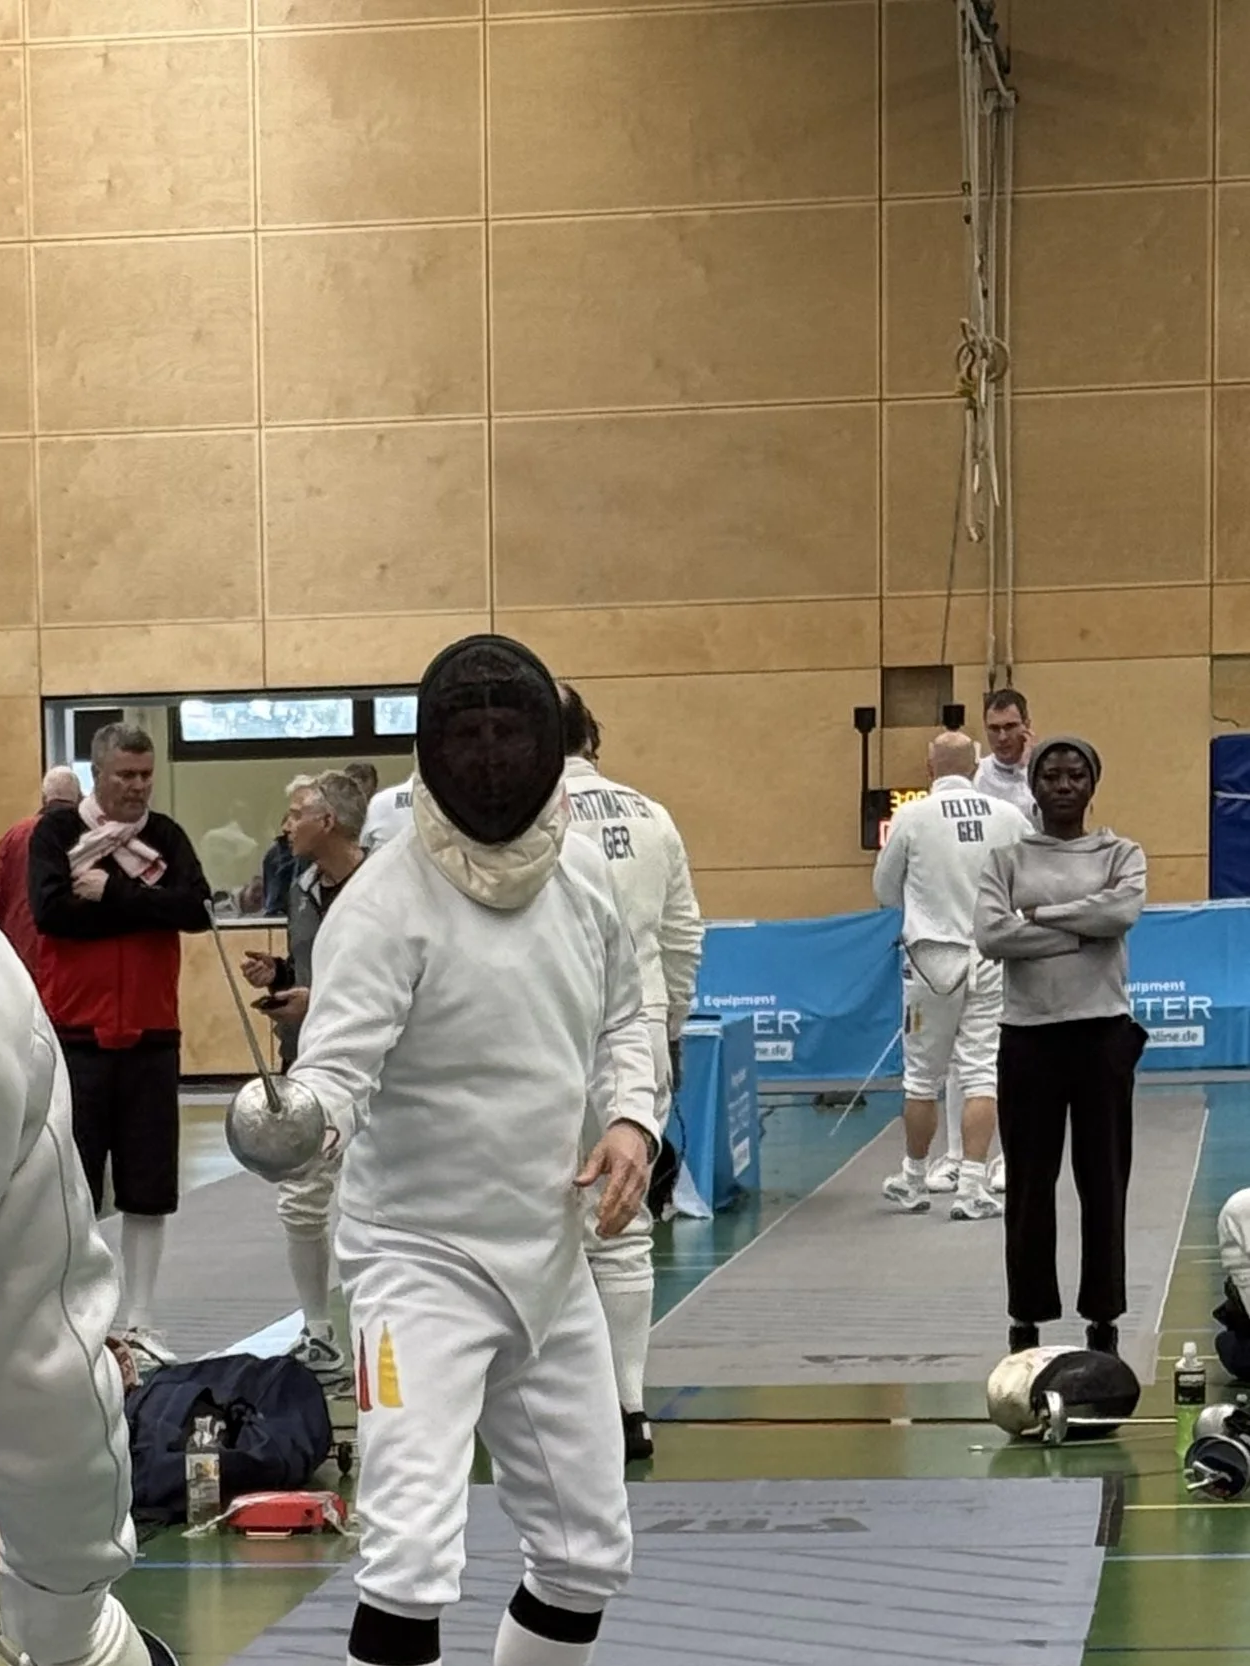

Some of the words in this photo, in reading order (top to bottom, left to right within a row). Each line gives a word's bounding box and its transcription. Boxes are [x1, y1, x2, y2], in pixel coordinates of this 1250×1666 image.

[602, 825, 636, 860] GER
[957, 820, 984, 842] GER
[703, 994, 777, 1008] Equipment
[753, 1010, 802, 1034] ER
